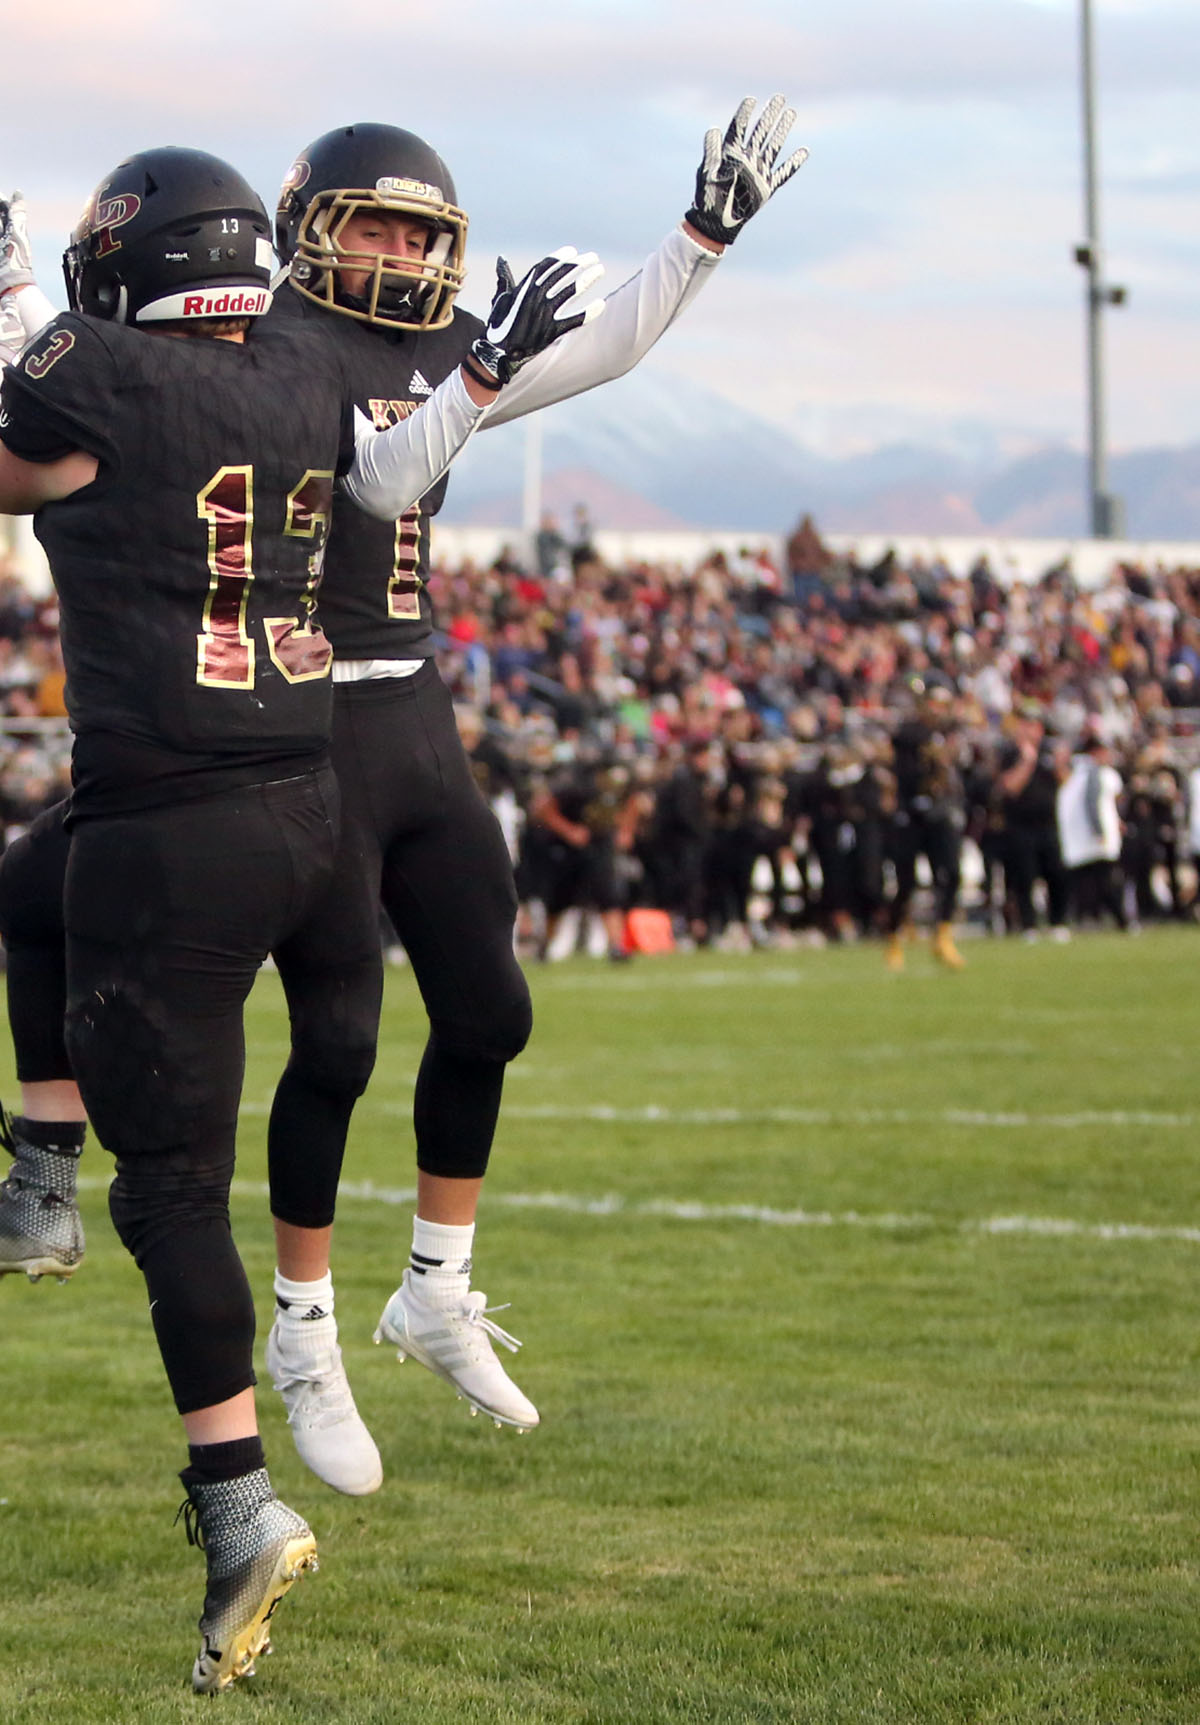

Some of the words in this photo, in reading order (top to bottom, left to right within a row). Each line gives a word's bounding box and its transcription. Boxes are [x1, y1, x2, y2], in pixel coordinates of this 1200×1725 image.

[394, 178, 427, 195] KNIGHTS
[221, 218, 239, 234] 13
[183, 293, 267, 316] Riddell
[25, 329, 76, 379] 3
[196, 464, 333, 690] 13
